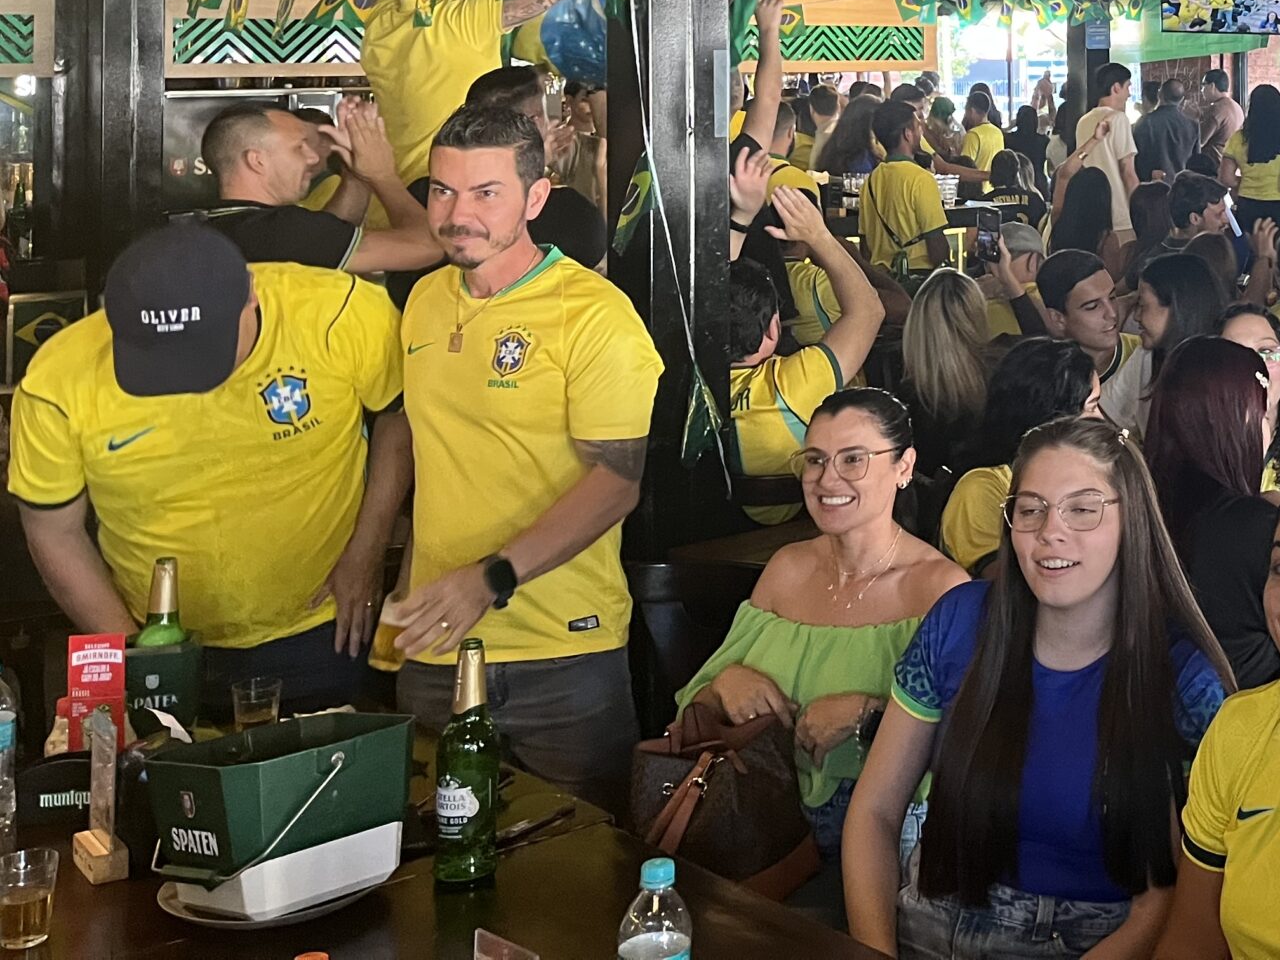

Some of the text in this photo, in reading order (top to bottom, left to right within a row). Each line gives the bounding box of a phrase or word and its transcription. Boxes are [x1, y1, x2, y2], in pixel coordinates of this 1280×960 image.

[487, 379, 520, 389] BRASIL
[272, 417, 322, 441] BRASIL
[39, 790, 91, 810] muniqu
[171, 827, 219, 856] SPATEN
